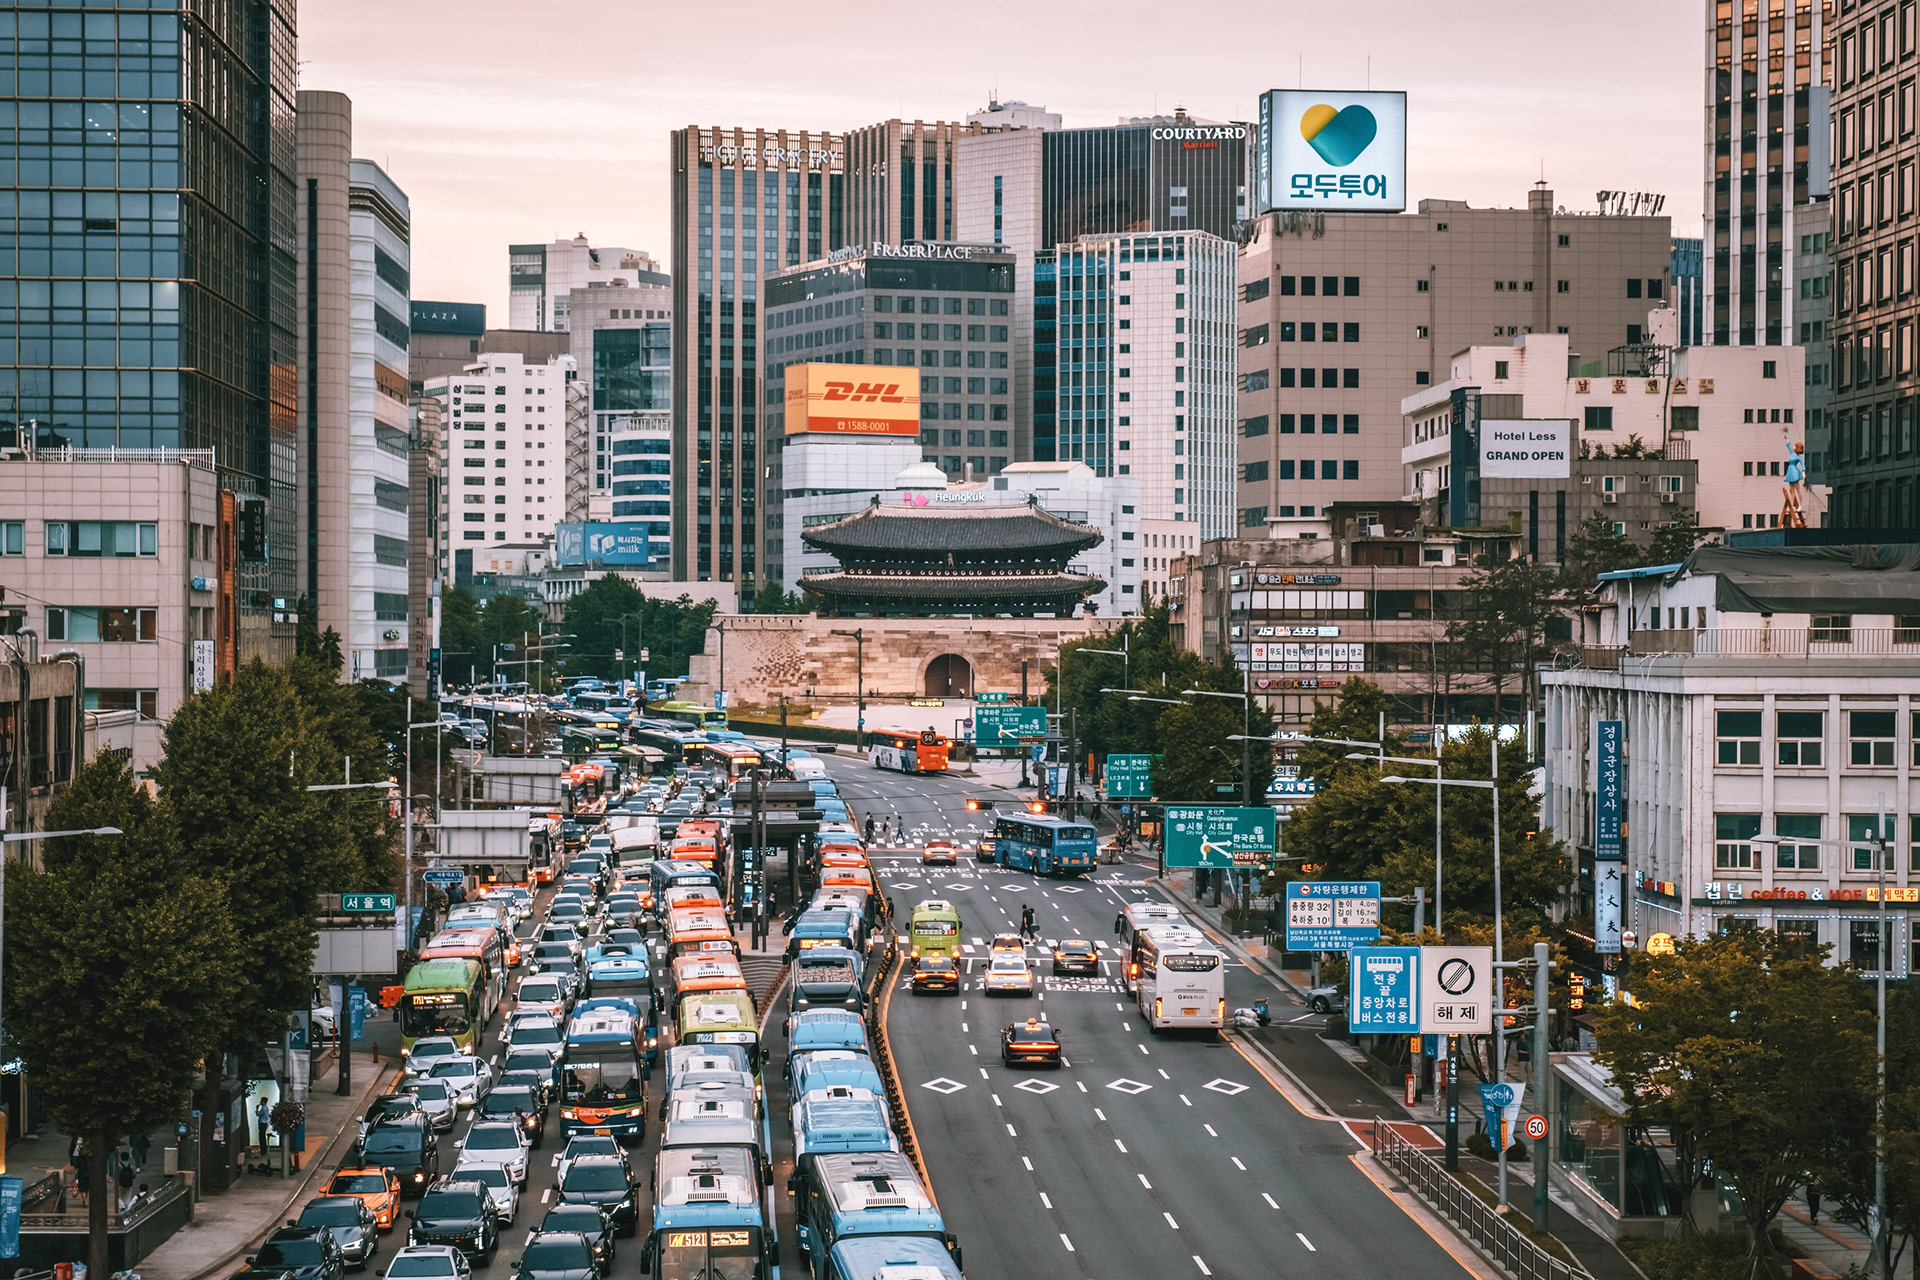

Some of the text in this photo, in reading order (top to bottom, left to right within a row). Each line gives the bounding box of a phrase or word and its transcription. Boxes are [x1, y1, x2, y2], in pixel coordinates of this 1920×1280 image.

[1152, 126, 1247, 142] COURTYARD
[1181, 139, 1218, 155] Marriott
[703, 145, 838, 165] HOTEL GRACERY
[1290, 173, 1388, 201] 모두투어
[413, 312, 458, 321] PLAZA
[823, 381, 905, 404] DHL
[848, 421, 890, 432] 1588-0001
[1494, 431, 1557, 441] Hotel Less
[1486, 450, 1565, 461] GRAND OPEN
[935, 493, 985, 505] Heungkuk
[1254, 648, 1264, 657] 영
[1286, 648, 1298, 657] 학원
[924, 734, 933, 742] 50
[1603, 726, 1618, 812] 경일군장상사
[1179, 810, 1204, 820] 광화문
[1186, 822, 1233, 831] 시청 시의회
[1233, 834, 1264, 843] 한국은행
[1234, 852, 1255, 860] 남산공원
[1312, 885, 1367, 895] 차량운행제한
[1704, 882, 1743, 900] 캡틴
[1751, 887, 1807, 901] coffee
[1811, 887, 1823, 901] &
[1829, 889, 1862, 901] HOF
[346, 897, 391, 909] 서울역
[1337, 900, 1377, 908] 높이 4.0m
[1605, 868, 1619, 933] 大丈夫
[1292, 901, 1314, 912] 총중량
[1337, 909, 1353, 917] 길이
[1292, 915, 1314, 925] 축하중
[1652, 937, 1672, 947] 호프
[1373, 973, 1397, 985] 전용
[1379, 985, 1391, 997] 끝
[1362, 996, 1409, 1009] 중앙차로
[1362, 1011, 1408, 1024] 버스전용
[1437, 1006, 1476, 1020] 해제
[697, 1033, 713, 1043] 7022
[1530, 1121, 1543, 1134] 50
